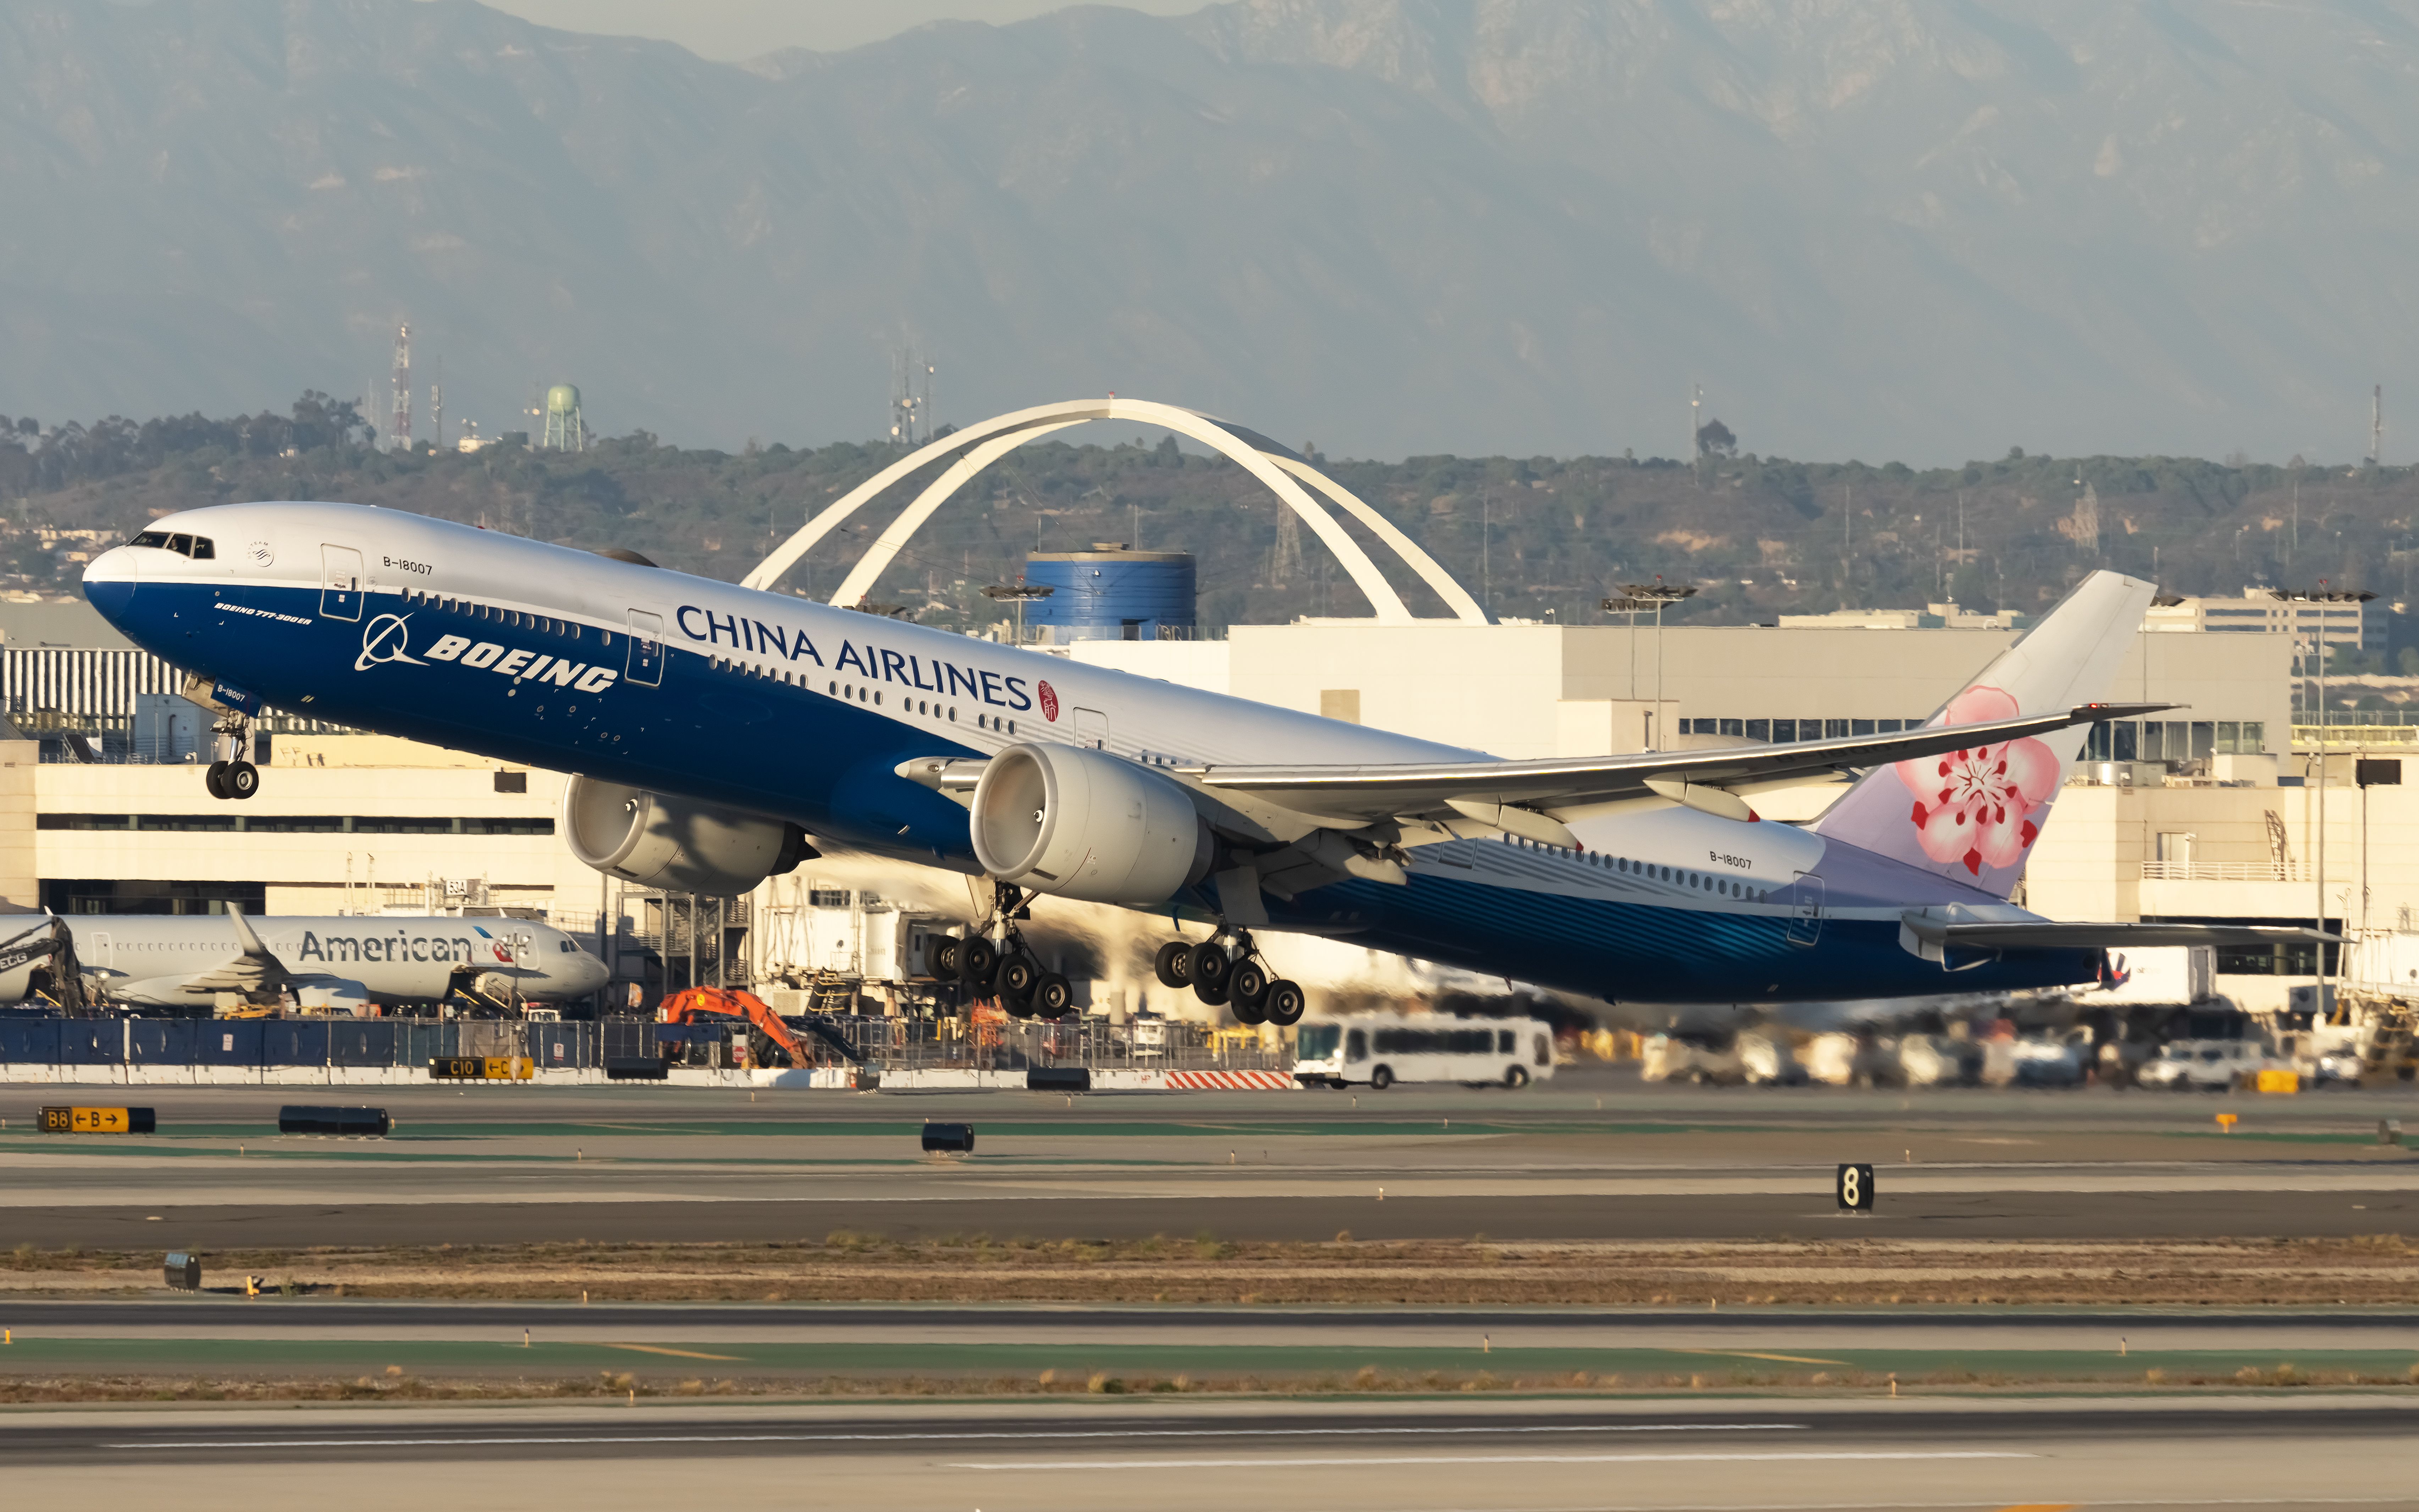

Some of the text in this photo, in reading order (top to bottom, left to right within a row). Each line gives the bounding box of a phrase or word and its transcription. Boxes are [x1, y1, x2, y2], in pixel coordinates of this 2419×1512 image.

[383, 556, 432, 575] B-18007
[214, 602, 255, 615] BOEING
[423, 634, 618, 693] BOEING
[677, 606, 1031, 711] CHINA AIRLINES
[217, 684, 245, 702] B-18007
[1710, 851, 1751, 869] B-18007
[299, 929, 472, 962] American
[450, 1060, 509, 1075] C10 C
[48, 1111, 100, 1127] B8 B
[1843, 1167, 1859, 1206] 8
